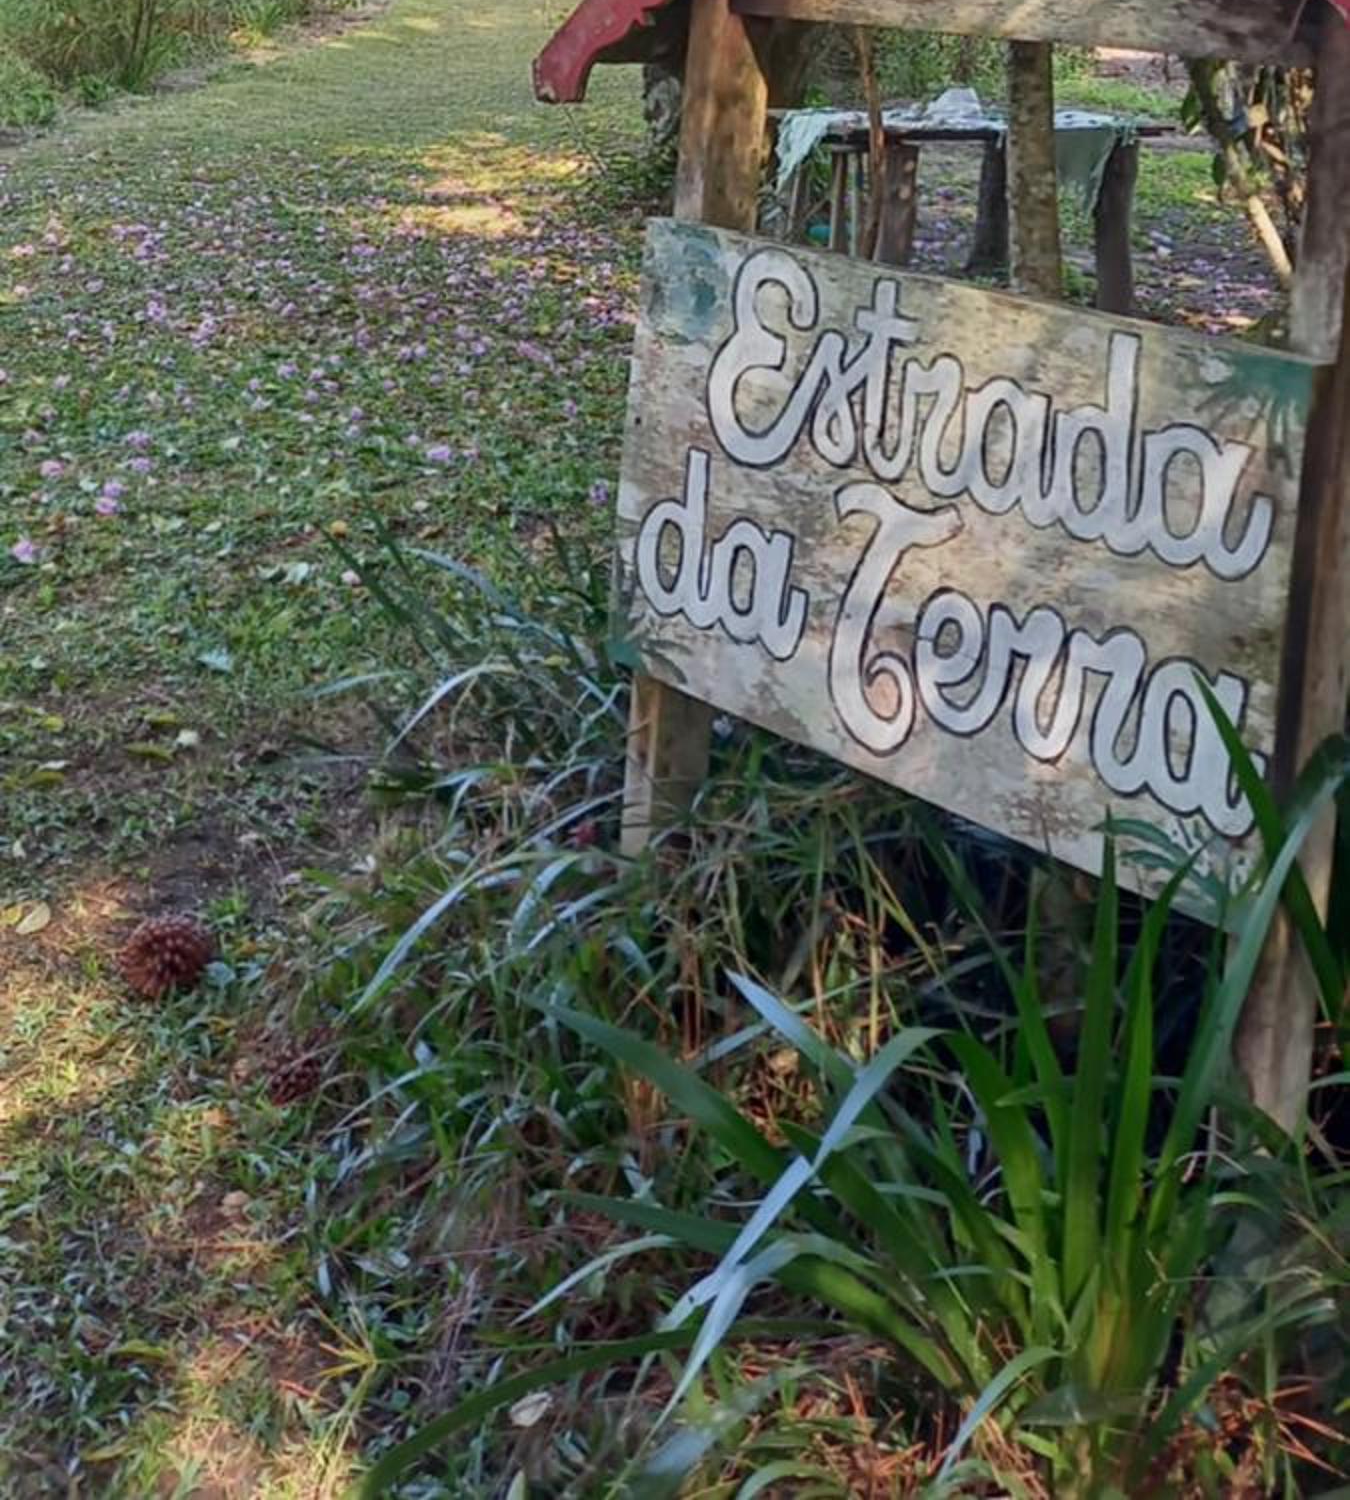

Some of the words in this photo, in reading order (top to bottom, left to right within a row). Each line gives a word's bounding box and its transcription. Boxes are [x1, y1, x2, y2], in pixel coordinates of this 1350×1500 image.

[707, 247, 1272, 580] Estrada
[636, 446, 809, 661] da
[828, 481, 1268, 838] Terra
